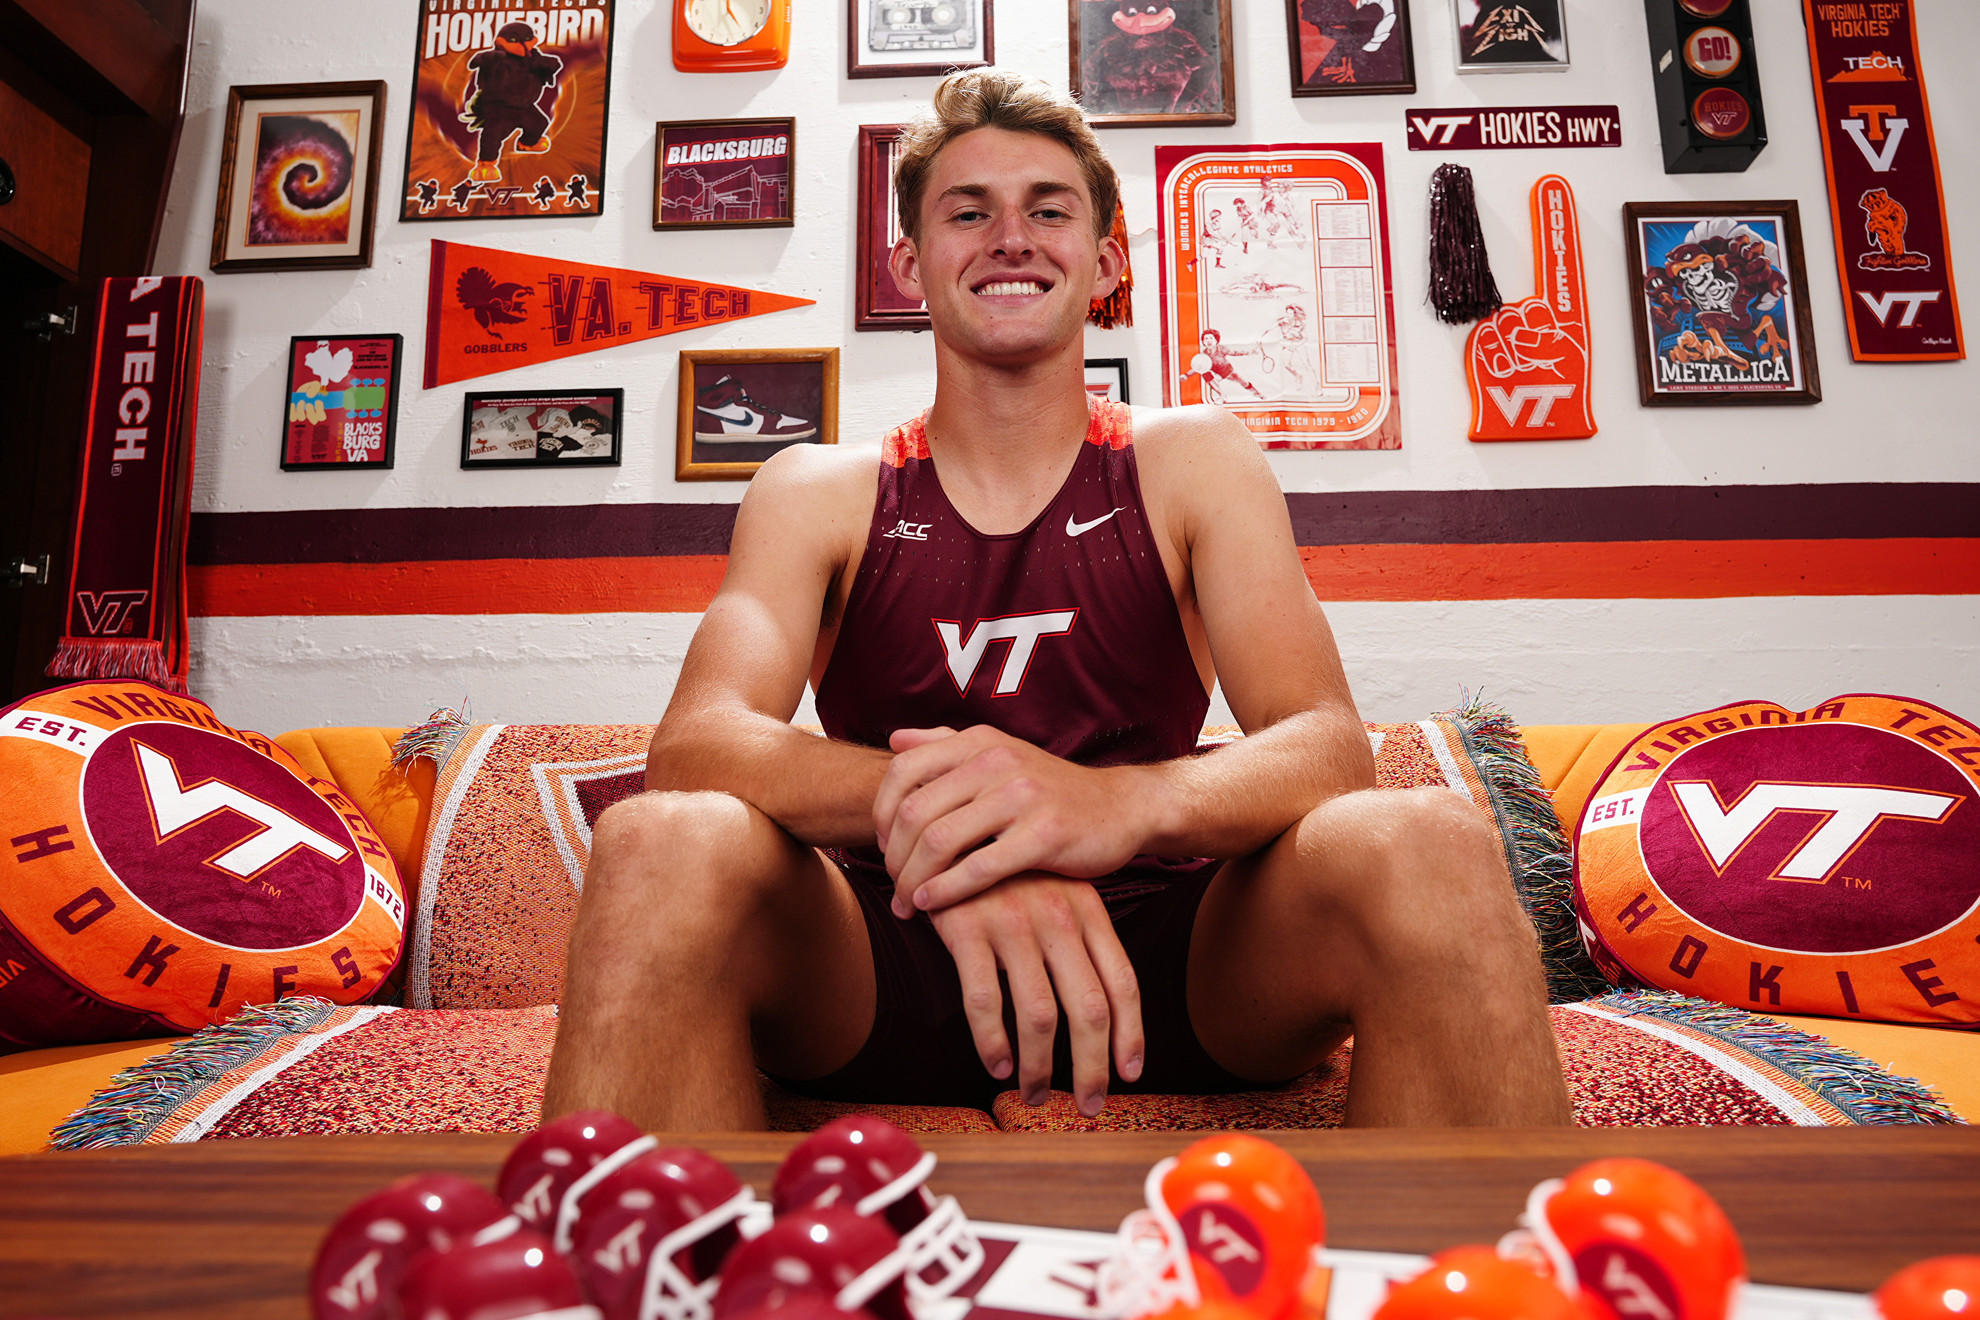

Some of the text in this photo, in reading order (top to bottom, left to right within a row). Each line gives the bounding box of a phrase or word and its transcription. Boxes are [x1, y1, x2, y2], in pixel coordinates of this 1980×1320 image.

[1817, 3, 1900, 21] VIRGINIA TECH
[425, 8, 605, 60] HOKIBIRD
[1831, 20, 1891, 38] HOKIES
[1697, 36, 1732, 62] GO!
[1843, 56, 1904, 70] TECH
[1410, 111, 1611, 145] VT HOKIES HWY
[1711, 111, 1737, 125] VT
[666, 136, 788, 165] BLACKSBURG
[1243, 164, 1293, 174] ATHLETICS
[484, 186, 523, 206] VT
[1547, 189, 1572, 312] HOKIES
[547, 273, 750, 347] VA. TECH
[1855, 290, 1943, 328] VT
[464, 342, 528, 355] GOBBLERS
[1659, 356, 1790, 383] METALLICA
[113, 311, 159, 461] TECH
[1485, 383, 1577, 428] VT
[344, 422, 383, 436] BLACKS
[1285, 417, 1308, 426] TECH
[1312, 417, 1336, 426] 1979
[343, 435, 381, 450] BURG
[346, 449, 368, 462] VA
[883, 519, 933, 541] ACC
[77, 590, 149, 635] VT
[931, 607, 1080, 699] VT
[14, 716, 87, 747] EST.
[1889, 708, 1980, 776] TEC
[129, 736, 354, 884] VT
[1592, 797, 1634, 824] EST.
[1667, 779, 1967, 885] VT
[261, 880, 282, 898] TM
[369, 873, 402, 919] 1872
[1841, 876, 1872, 891] TM
[1616, 892, 1980, 1014] HOKIE
